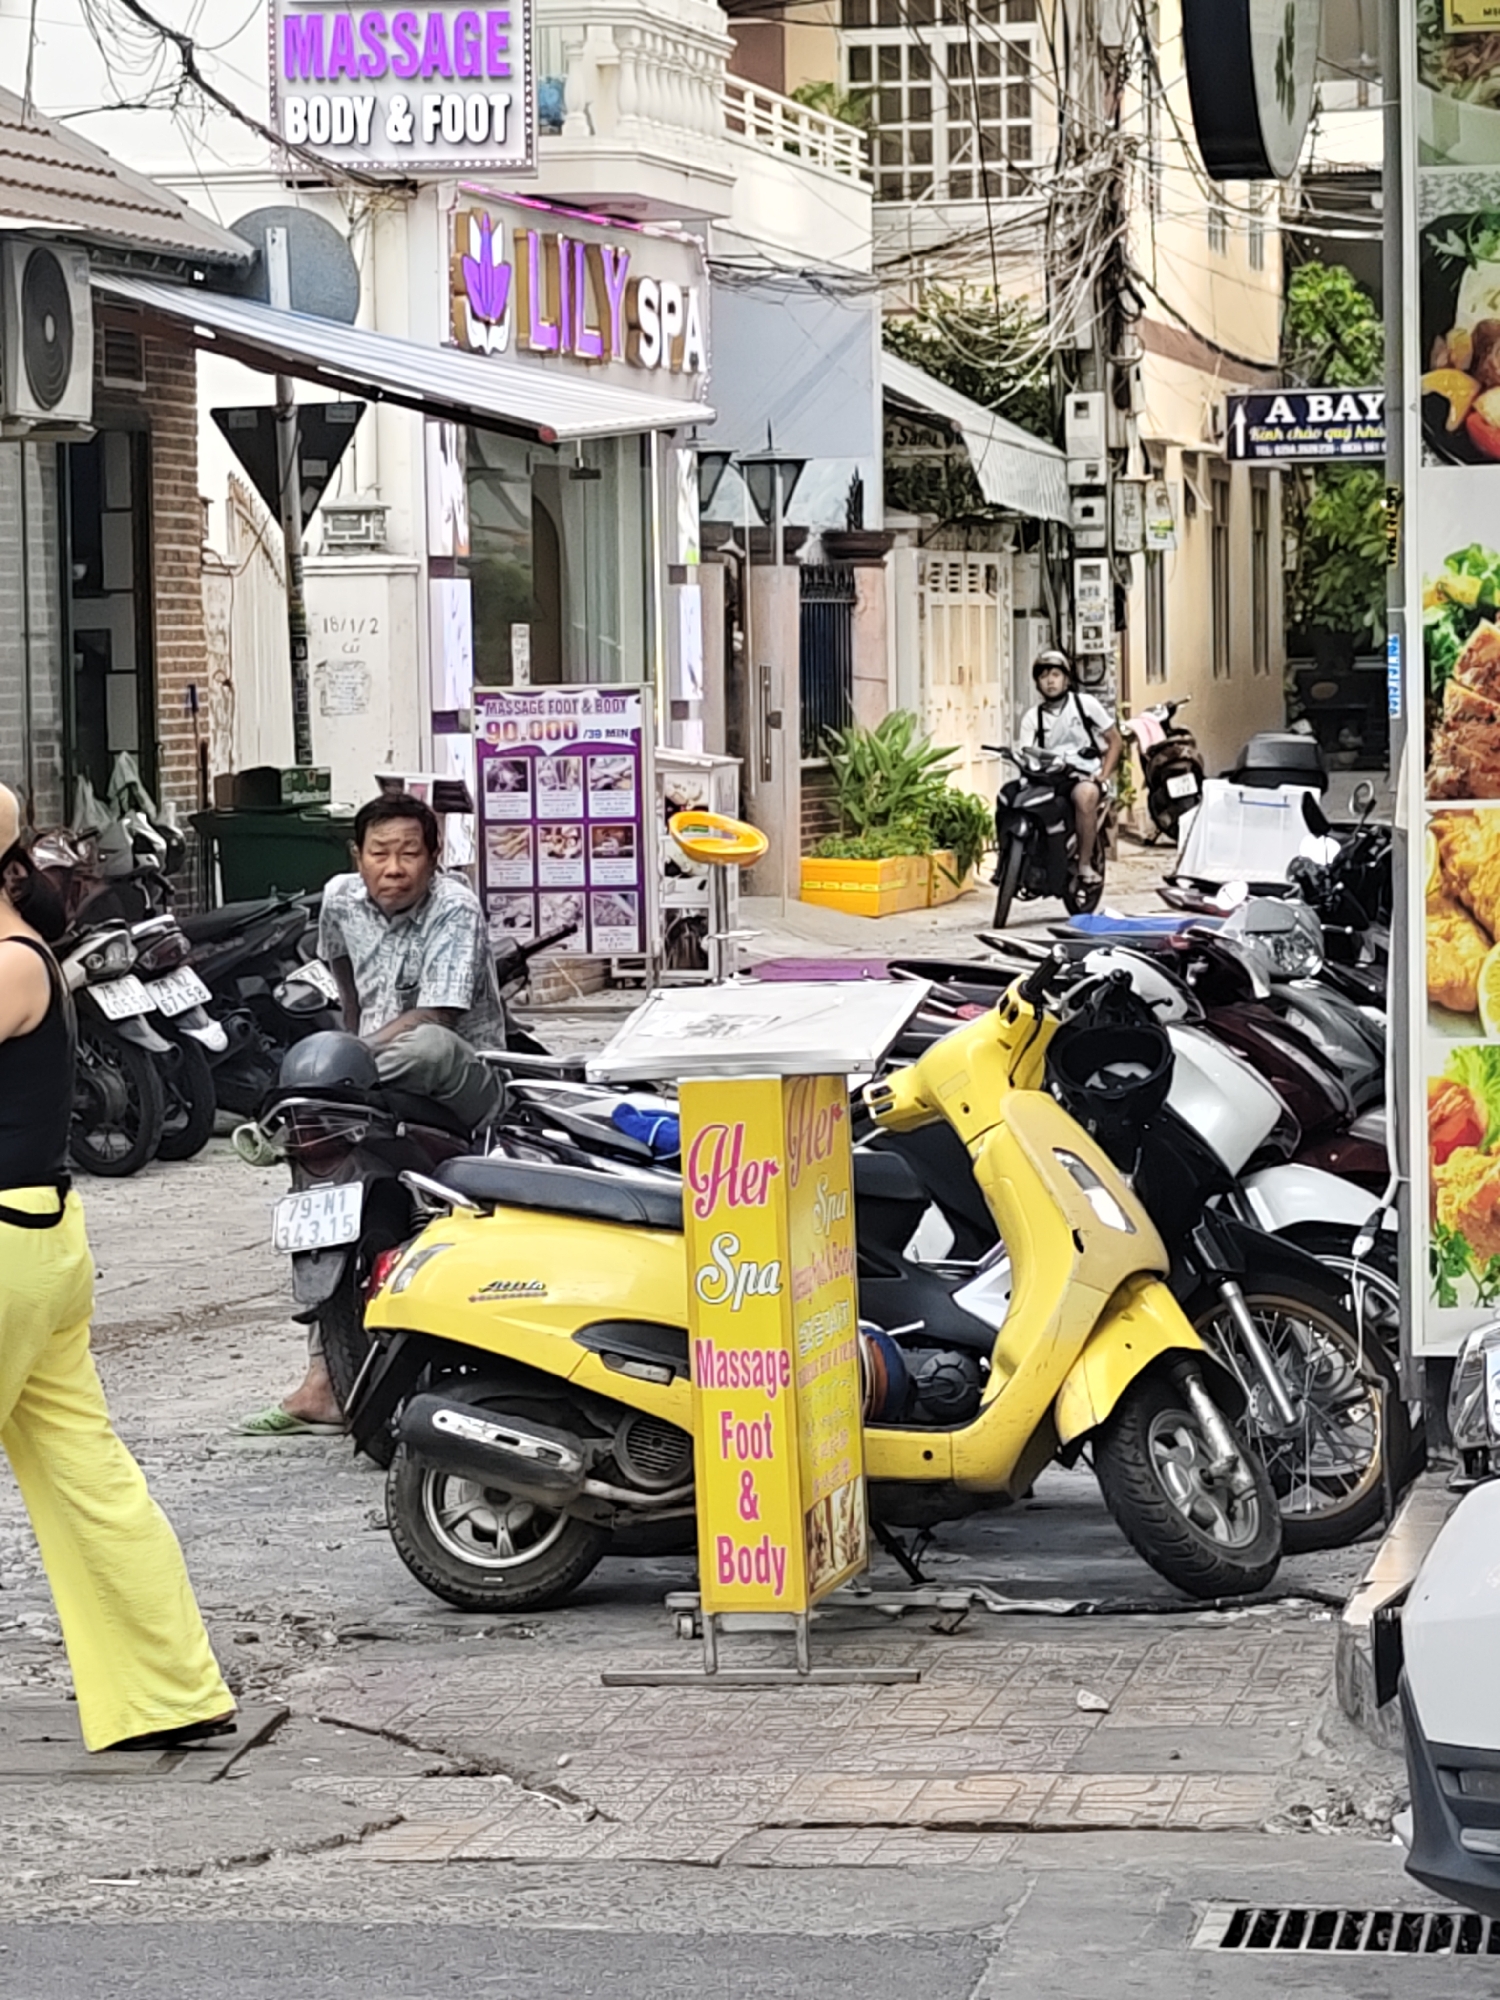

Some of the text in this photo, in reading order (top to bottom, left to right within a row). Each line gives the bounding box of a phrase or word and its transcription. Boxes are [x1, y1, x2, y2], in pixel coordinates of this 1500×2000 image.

[283, 10, 511, 80] MASSAGE
[284, 92, 512, 146] BODY & FOOT
[518, 229, 706, 374] LILY SPA
[1265, 393, 1386, 424] A BAY
[323, 615, 379, 635] 18/1/2
[485, 698, 628, 717] MASSAGE FOOT & BODY
[485, 719, 579, 744] 90.000
[605, 728, 629, 739] MIN
[688, 1121, 781, 1219] Her
[279, 1214, 354, 1249] 343.15
[289, 1190, 346, 1222] 79-N1
[813, 1172, 848, 1238] Spa
[695, 1231, 783, 1312] Spa
[694, 1338, 790, 1399] Massage
[720, 1410, 774, 1461] Foot
[738, 1468, 759, 1521] &
[716, 1533, 787, 1598] Body
